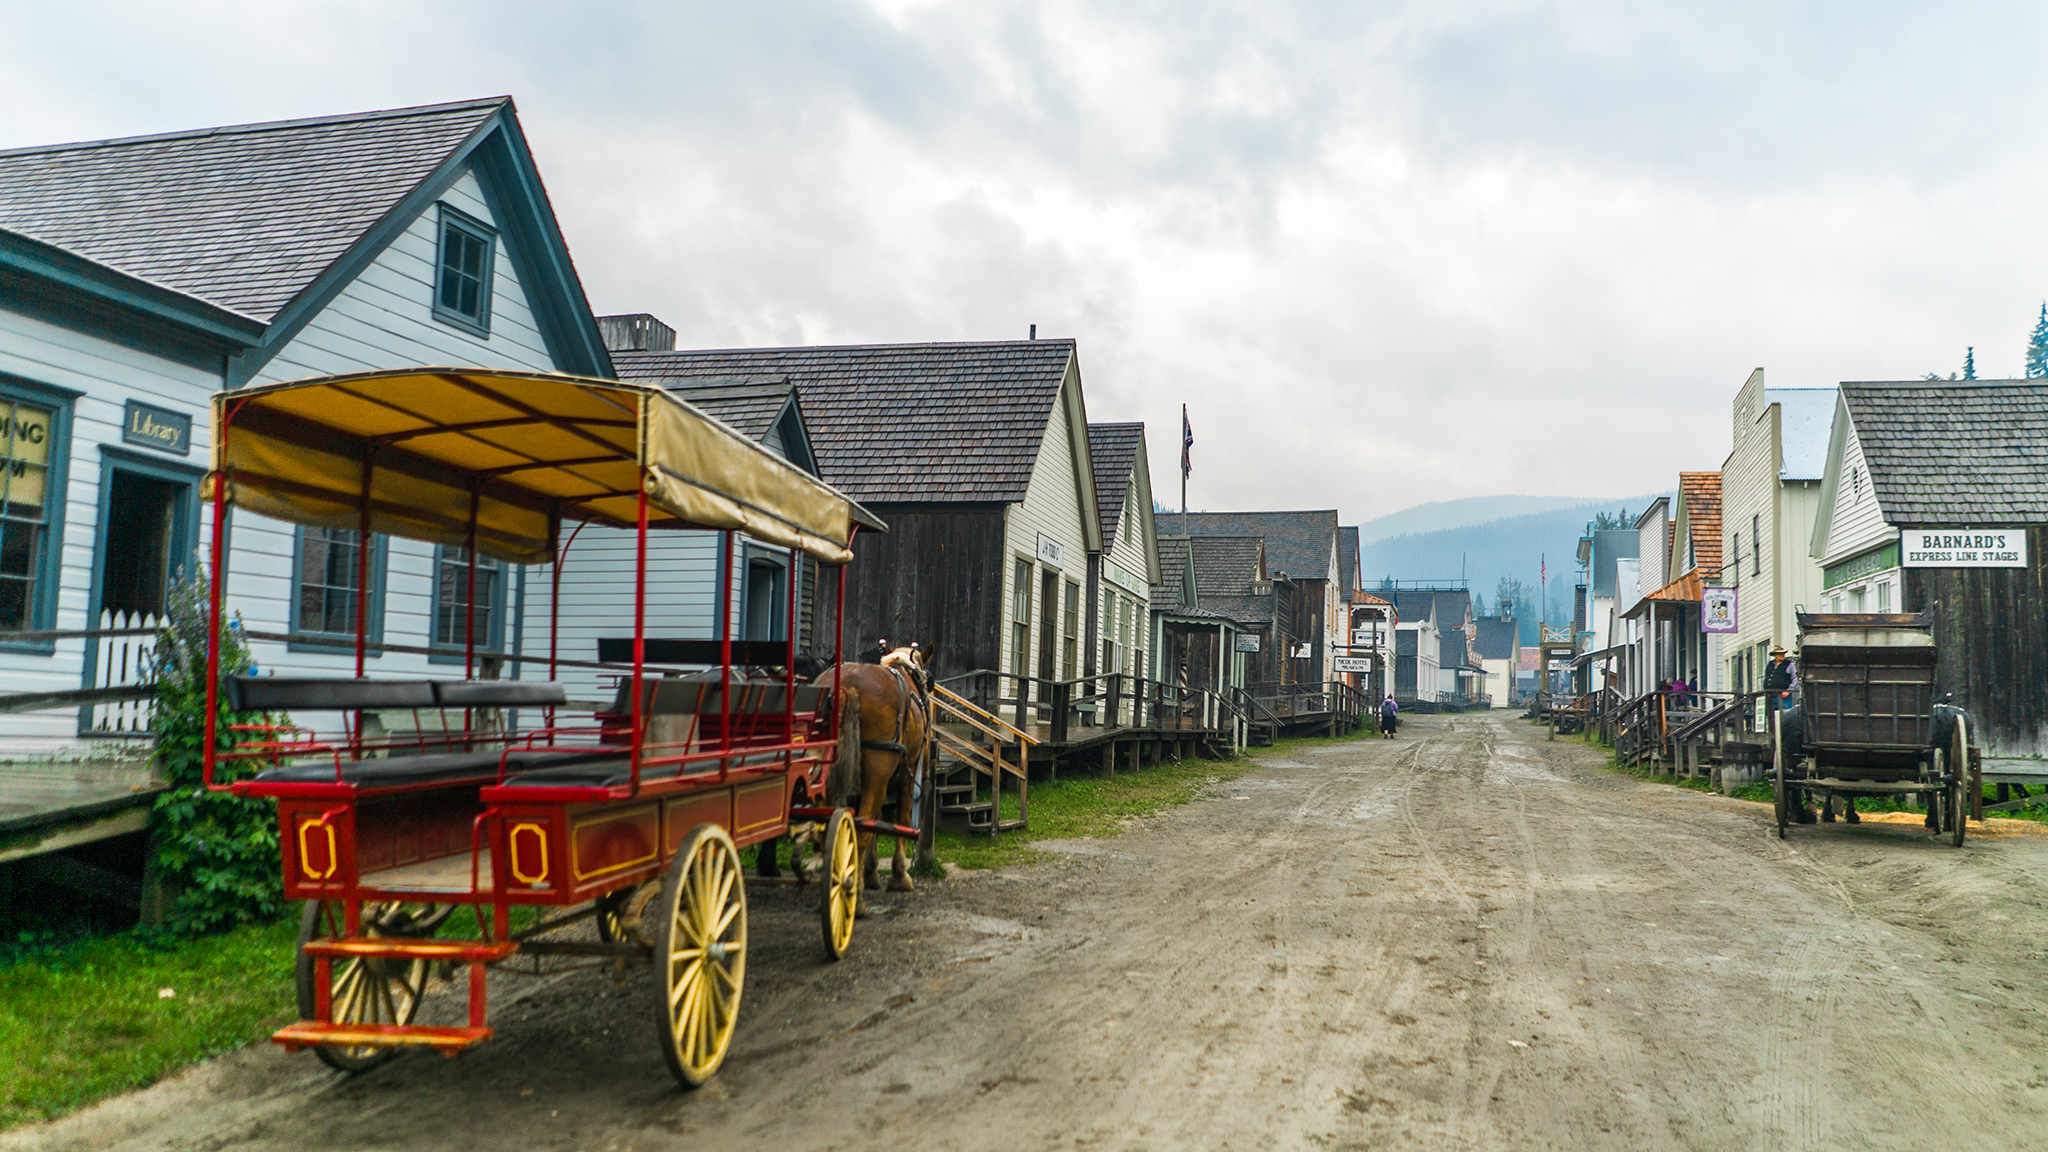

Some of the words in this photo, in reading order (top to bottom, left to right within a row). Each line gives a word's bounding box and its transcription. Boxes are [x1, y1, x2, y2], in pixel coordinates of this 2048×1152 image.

[0, 416, 44, 444] ING
[132, 410, 182, 447] Library
[1922, 535, 2006, 549] BARNARD'S
[1847, 550, 1881, 580] BARNARD
[1909, 551, 1952, 561] EXPRESS
[1956, 551, 1978, 561] LINE
[1982, 551, 2018, 561] STAGES
[1706, 617, 1734, 626] Bakery
